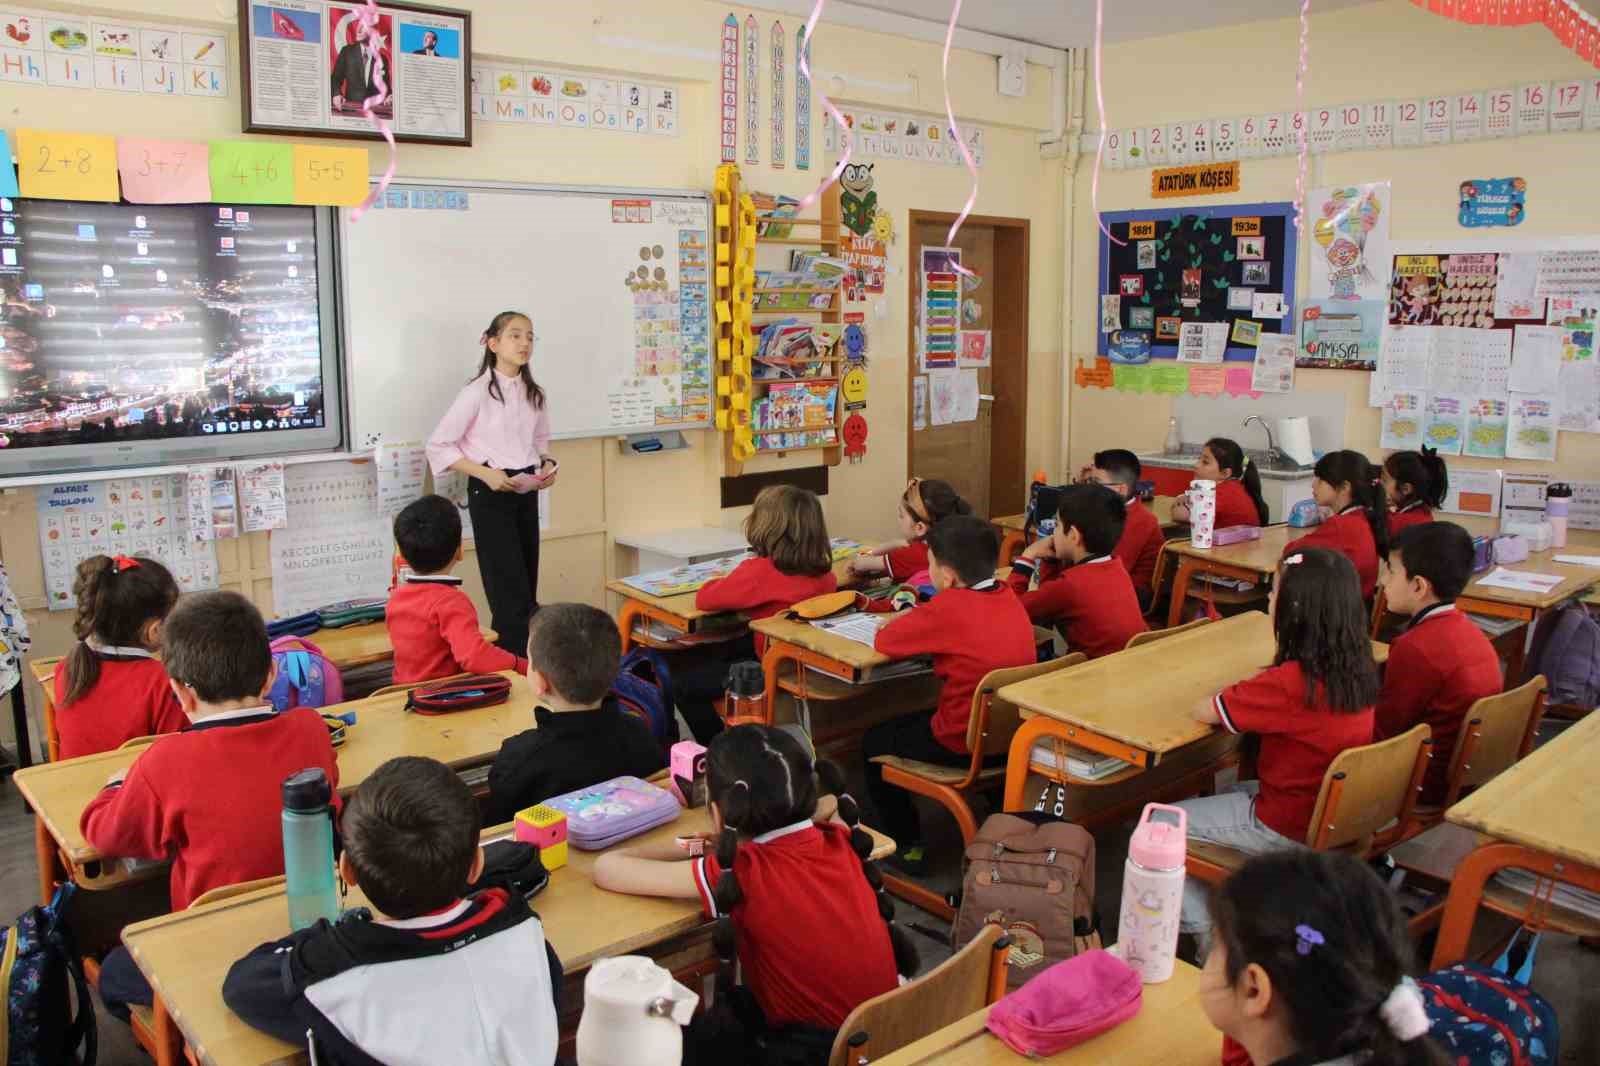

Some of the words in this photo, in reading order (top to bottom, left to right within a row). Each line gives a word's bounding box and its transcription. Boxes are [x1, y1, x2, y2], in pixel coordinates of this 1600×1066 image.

[4, 53, 40, 78] Hh
[155, 66, 175, 92] Jj
[193, 70, 220, 91] Kk
[496, 101, 525, 118] Mm
[532, 103, 554, 119] Nn
[560, 105, 586, 122] Oo
[626, 110, 644, 133] Pp
[656, 114, 673, 130] Rr
[1109, 134, 1119, 149] 0
[1132, 131, 1137, 146] 1
[1151, 128, 1161, 144] 2
[1174, 126, 1183, 142] 3
[1194, 124, 1204, 138] 4
[1220, 123, 1230, 140] 5
[1243, 118, 1254, 134] 6
[1268, 118, 1278, 135] 7
[1293, 112, 1303, 130] 8
[1319, 110, 1329, 127] 9
[1342, 107, 1360, 125] 10
[1372, 105, 1385, 122] 11
[1399, 103, 1417, 121] 12
[1429, 100, 1447, 118] 13
[1458, 97, 1478, 115] 14
[1490, 94, 1512, 113] 15
[1524, 85, 1544, 105] 16
[1559, 85, 1580, 106] 17
[36, 145, 93, 174] 2+8
[230, 153, 279, 184] 4+6
[1158, 171, 1197, 193] ATATÜRK
[1200, 166, 1233, 191] KÖŞESİ
